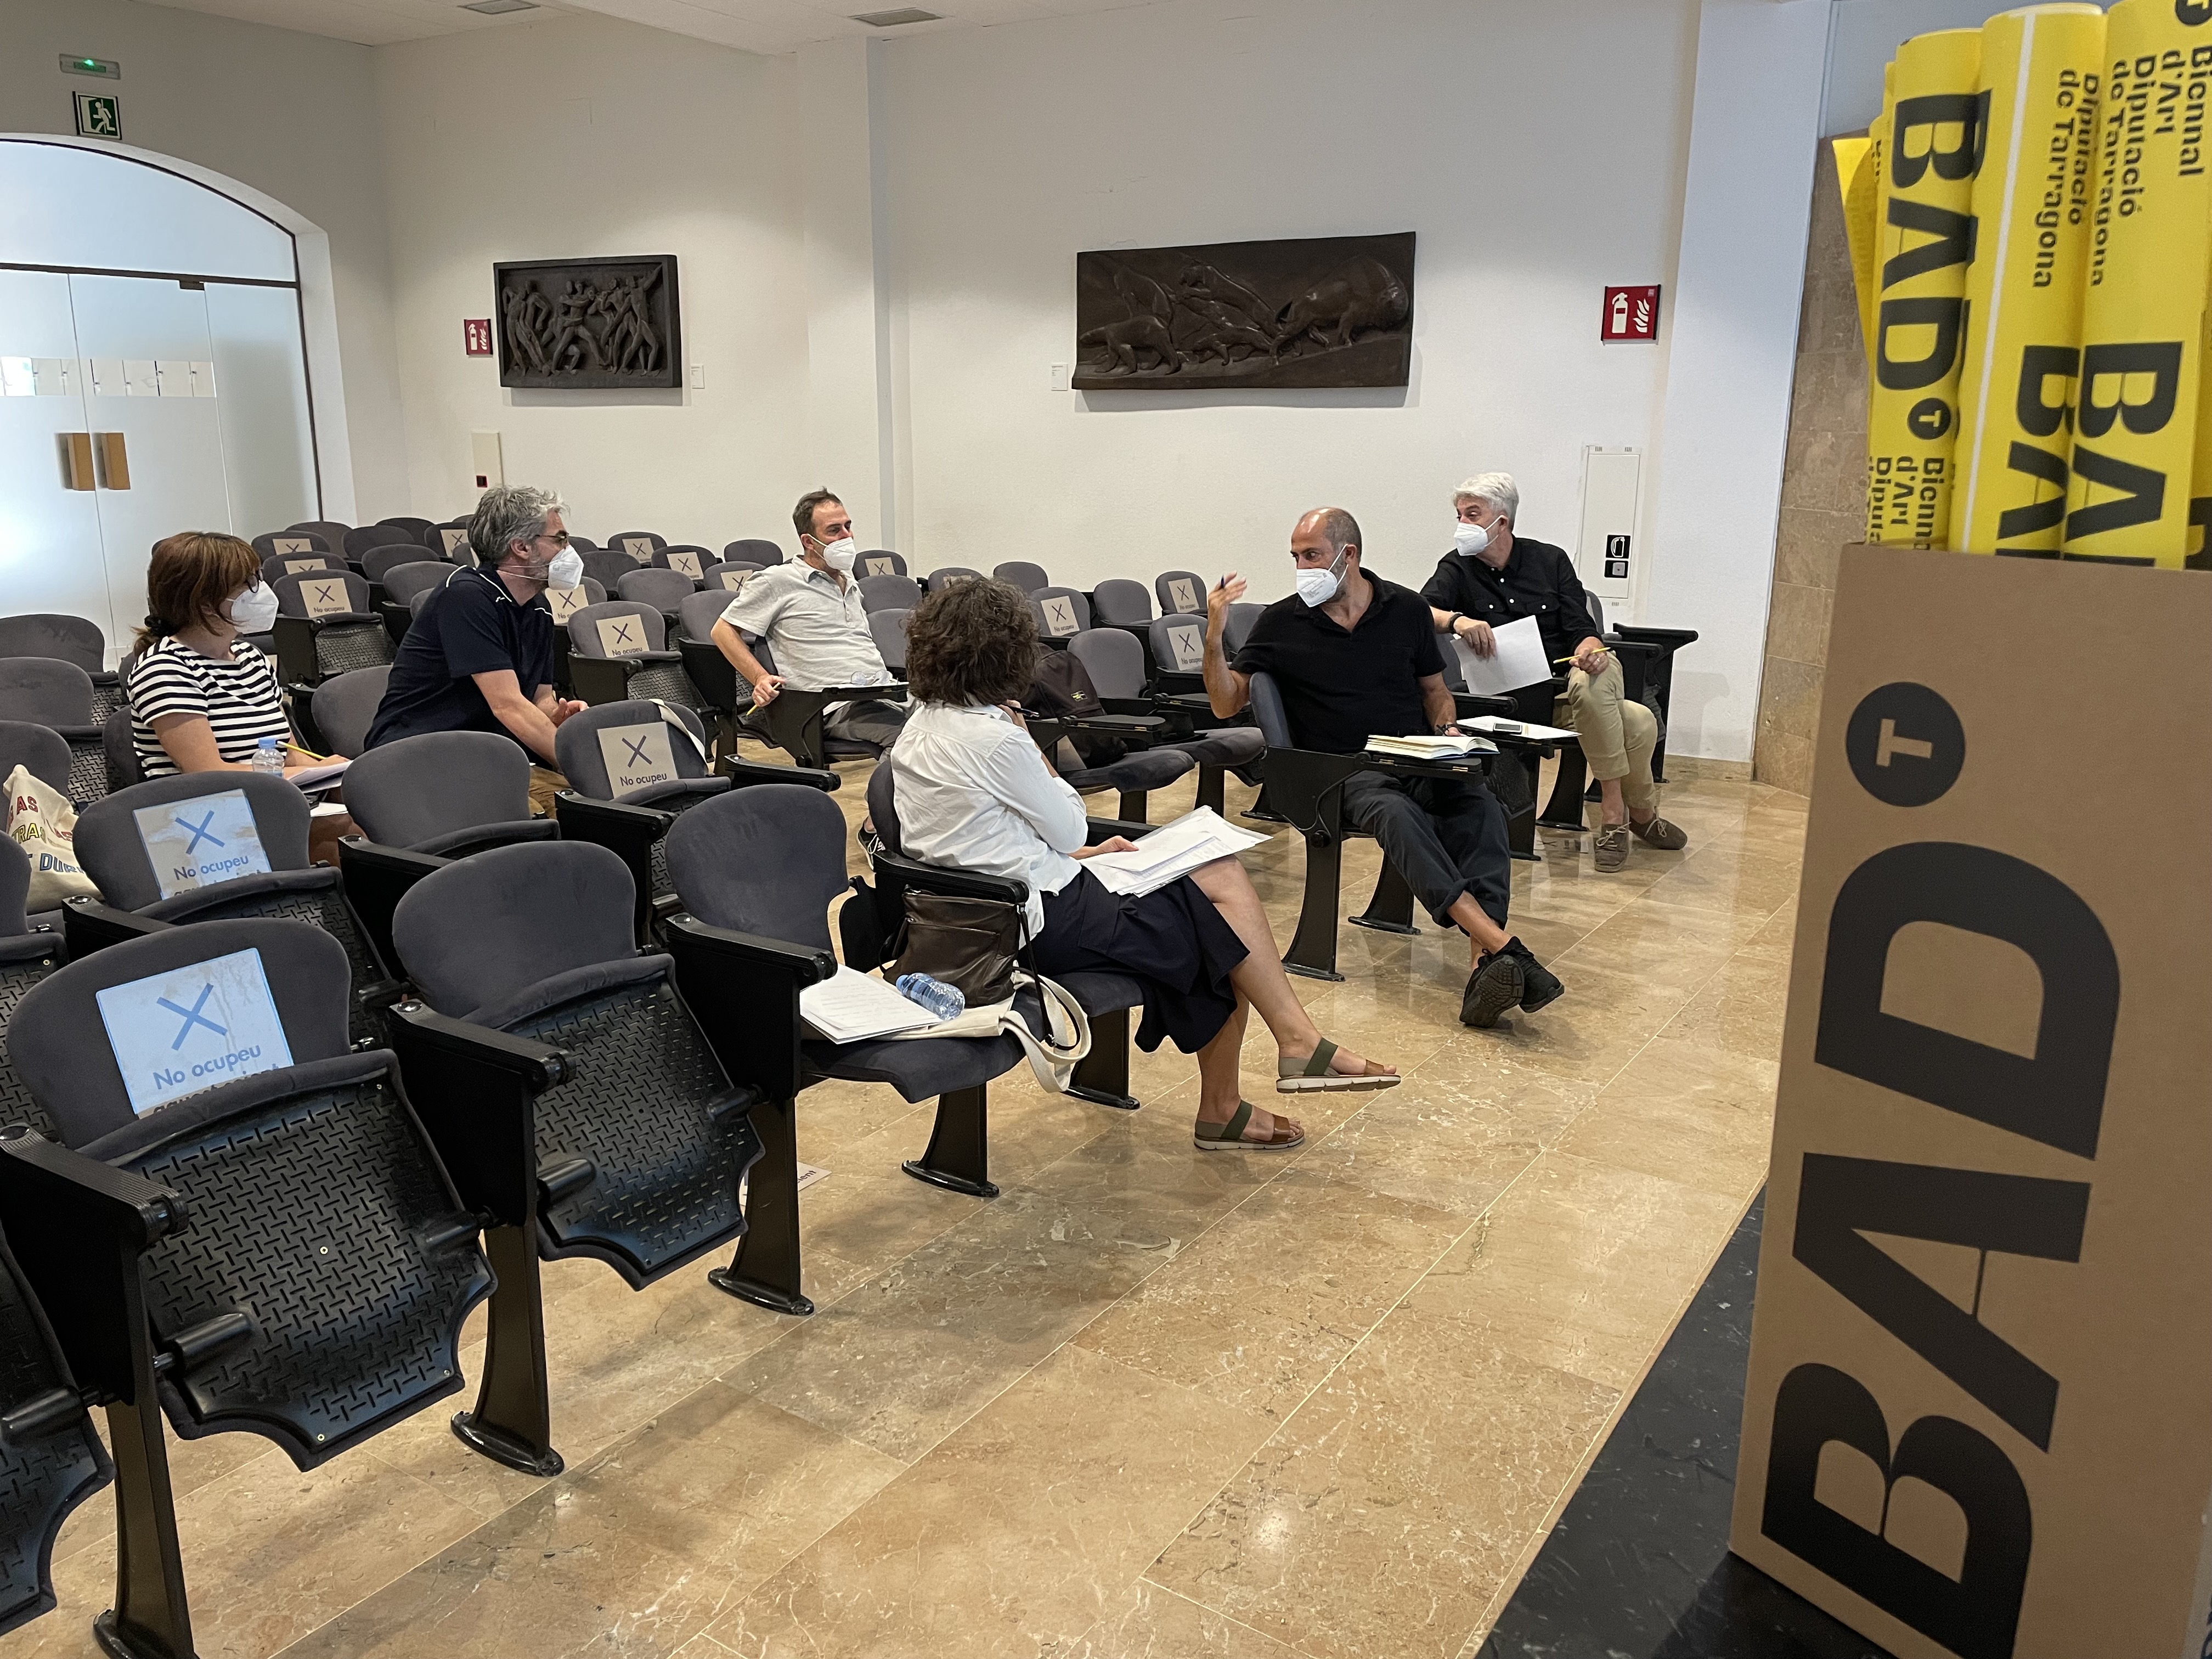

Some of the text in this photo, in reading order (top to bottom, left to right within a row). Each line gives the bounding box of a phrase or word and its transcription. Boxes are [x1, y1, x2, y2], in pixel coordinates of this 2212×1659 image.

[1876, 89, 1987, 391] BAD
[2033, 117, 2075, 288] Tarragona
[1995, 345, 2080, 559] BA
[2064, 342, 2182, 567] BA
[173, 855, 249, 881] No ocupeu
[619, 773, 667, 786] No ocupeu
[153, 1068, 185, 1090] No
[191, 1045, 261, 1077] ocupeu
[1761, 841, 2120, 1659] BAD
